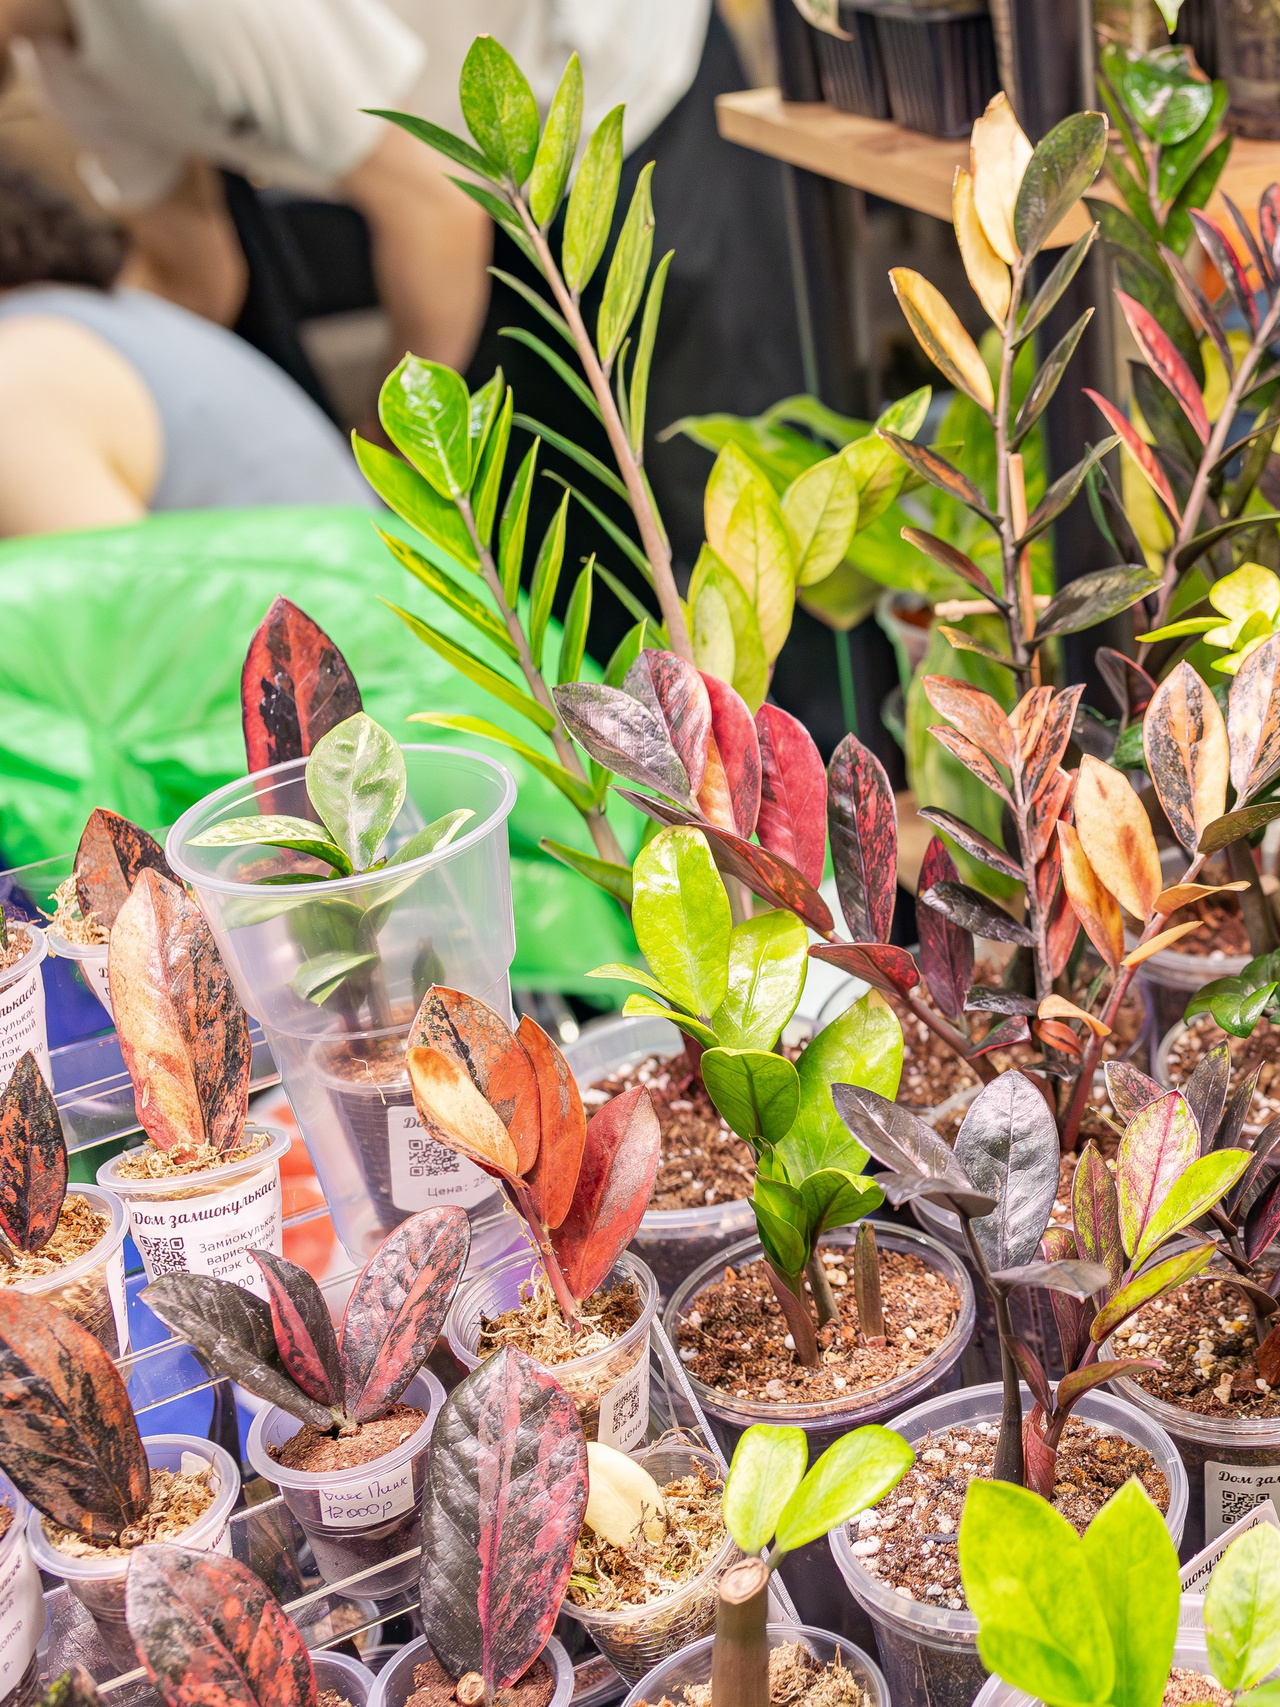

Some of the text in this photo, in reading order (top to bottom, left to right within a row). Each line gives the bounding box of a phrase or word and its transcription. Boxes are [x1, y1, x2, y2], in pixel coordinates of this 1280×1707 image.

[403, 1116, 424, 1129] До
[428, 1184, 468, 1197] Цена:
[132, 1211, 166, 1226] Дом
[199, 1212, 277, 1254] Замиокулькас
[212, 1260, 242, 1278] Блэк
[1218, 1470, 1253, 1485] Дом
